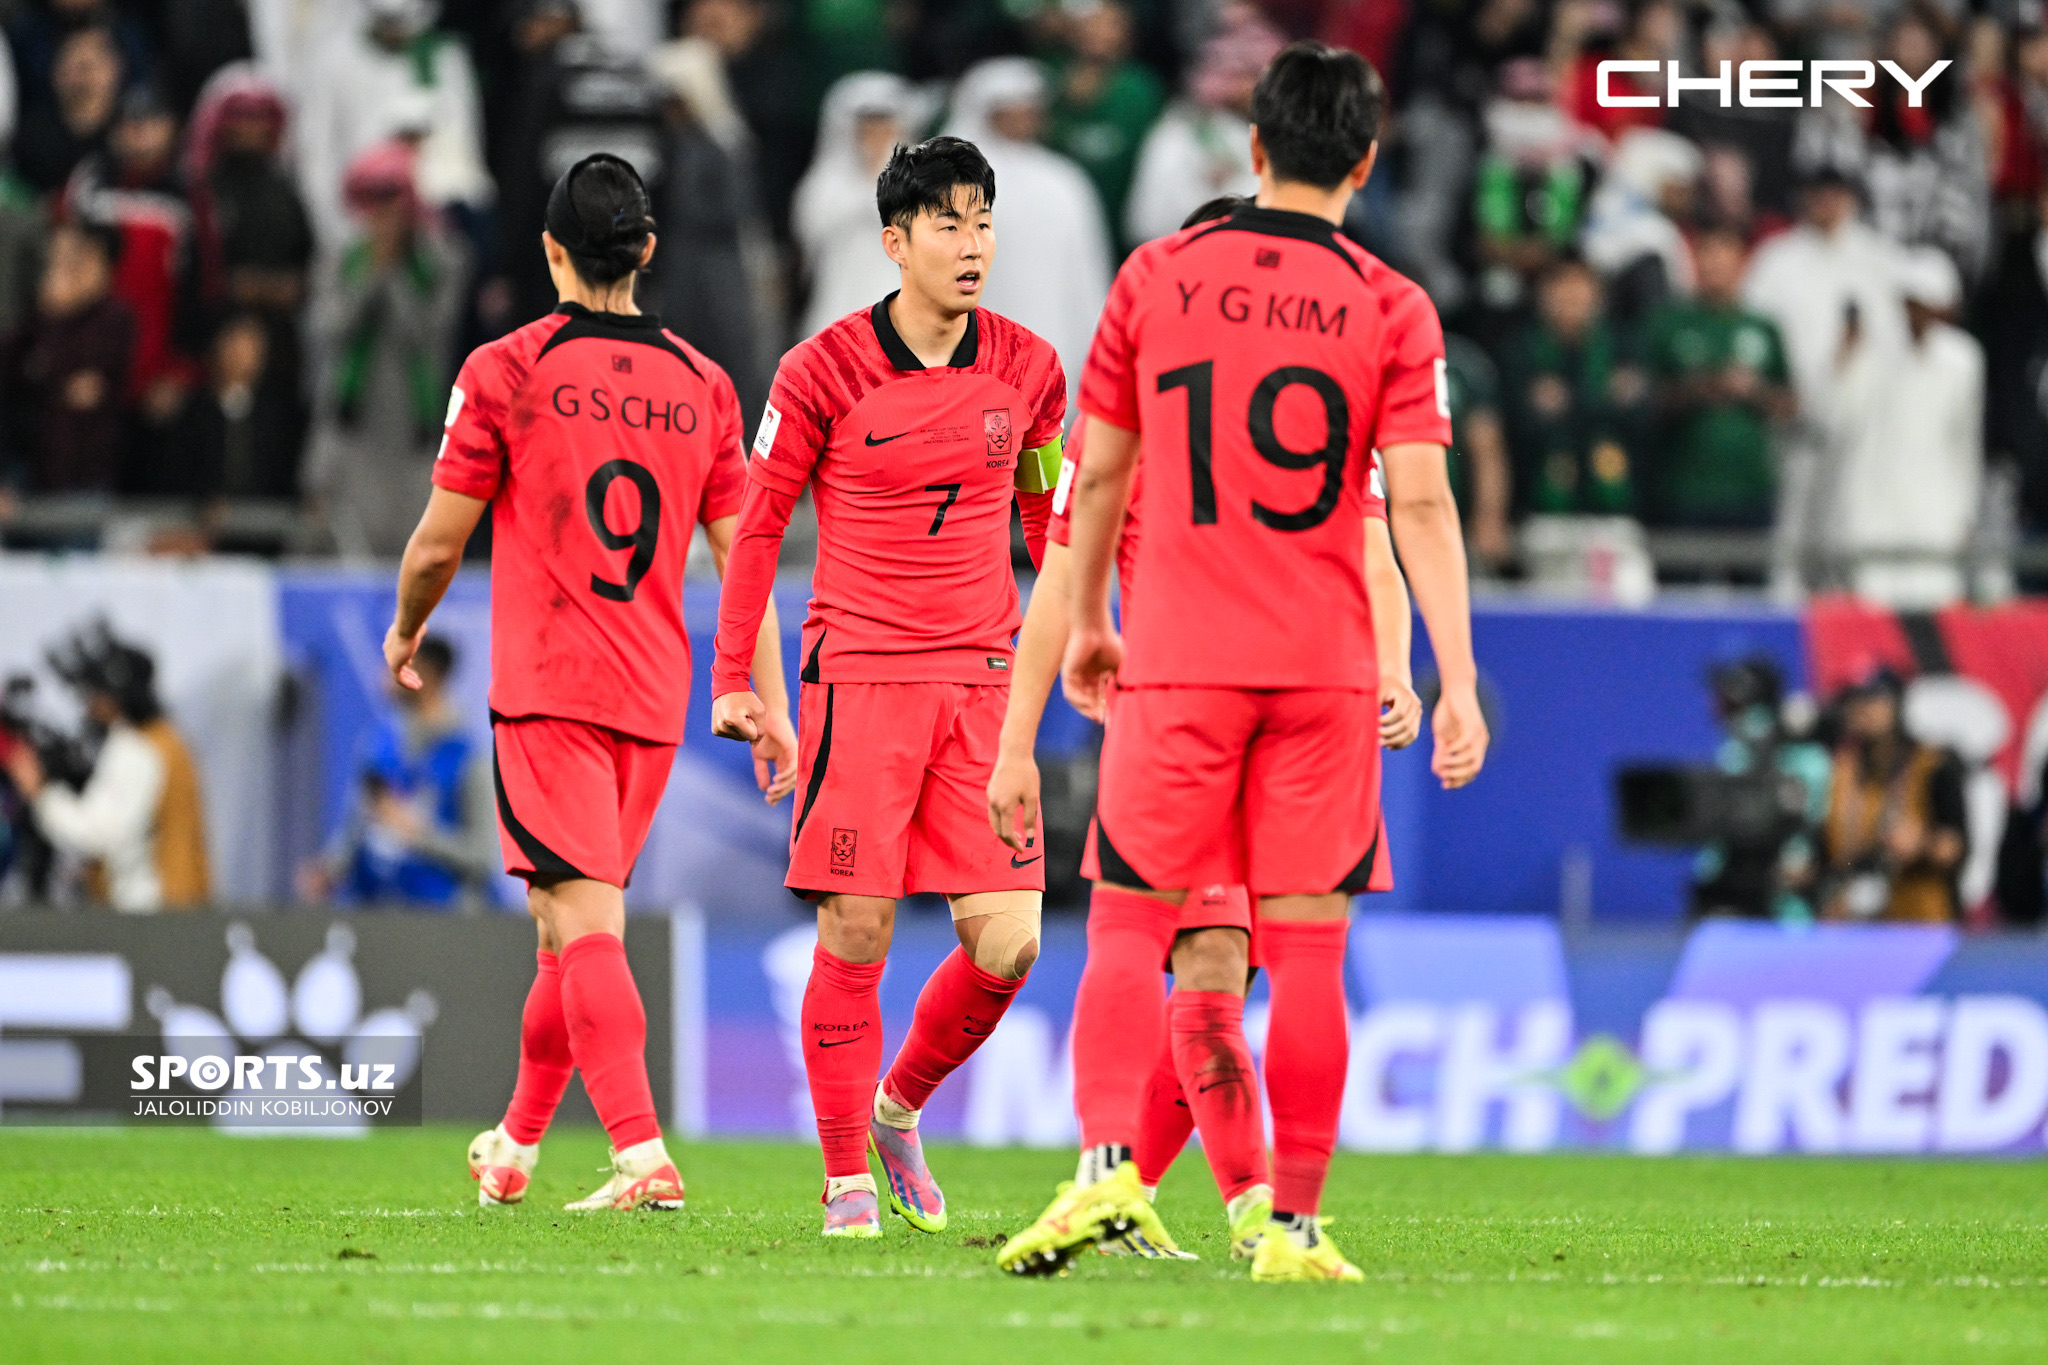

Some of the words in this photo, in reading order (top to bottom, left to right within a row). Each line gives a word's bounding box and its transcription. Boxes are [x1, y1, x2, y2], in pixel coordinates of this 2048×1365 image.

[1177, 280, 1202, 315] Y
[1220, 286, 1251, 323] G
[1265, 294, 1348, 338] KIM
[552, 384, 580, 417] G
[590, 388, 611, 421] S
[620, 396, 697, 435] CHO
[986, 459, 1009, 468] KOREA
[1156, 359, 1351, 533] 19
[585, 458, 662, 603] 9
[924, 483, 963, 537] 7
[830, 868, 854, 877] KOREA
[814, 1021, 869, 1032] KOREA
[968, 1000, 1576, 1149] MCH
[1628, 996, 2048, 1152] PRED
